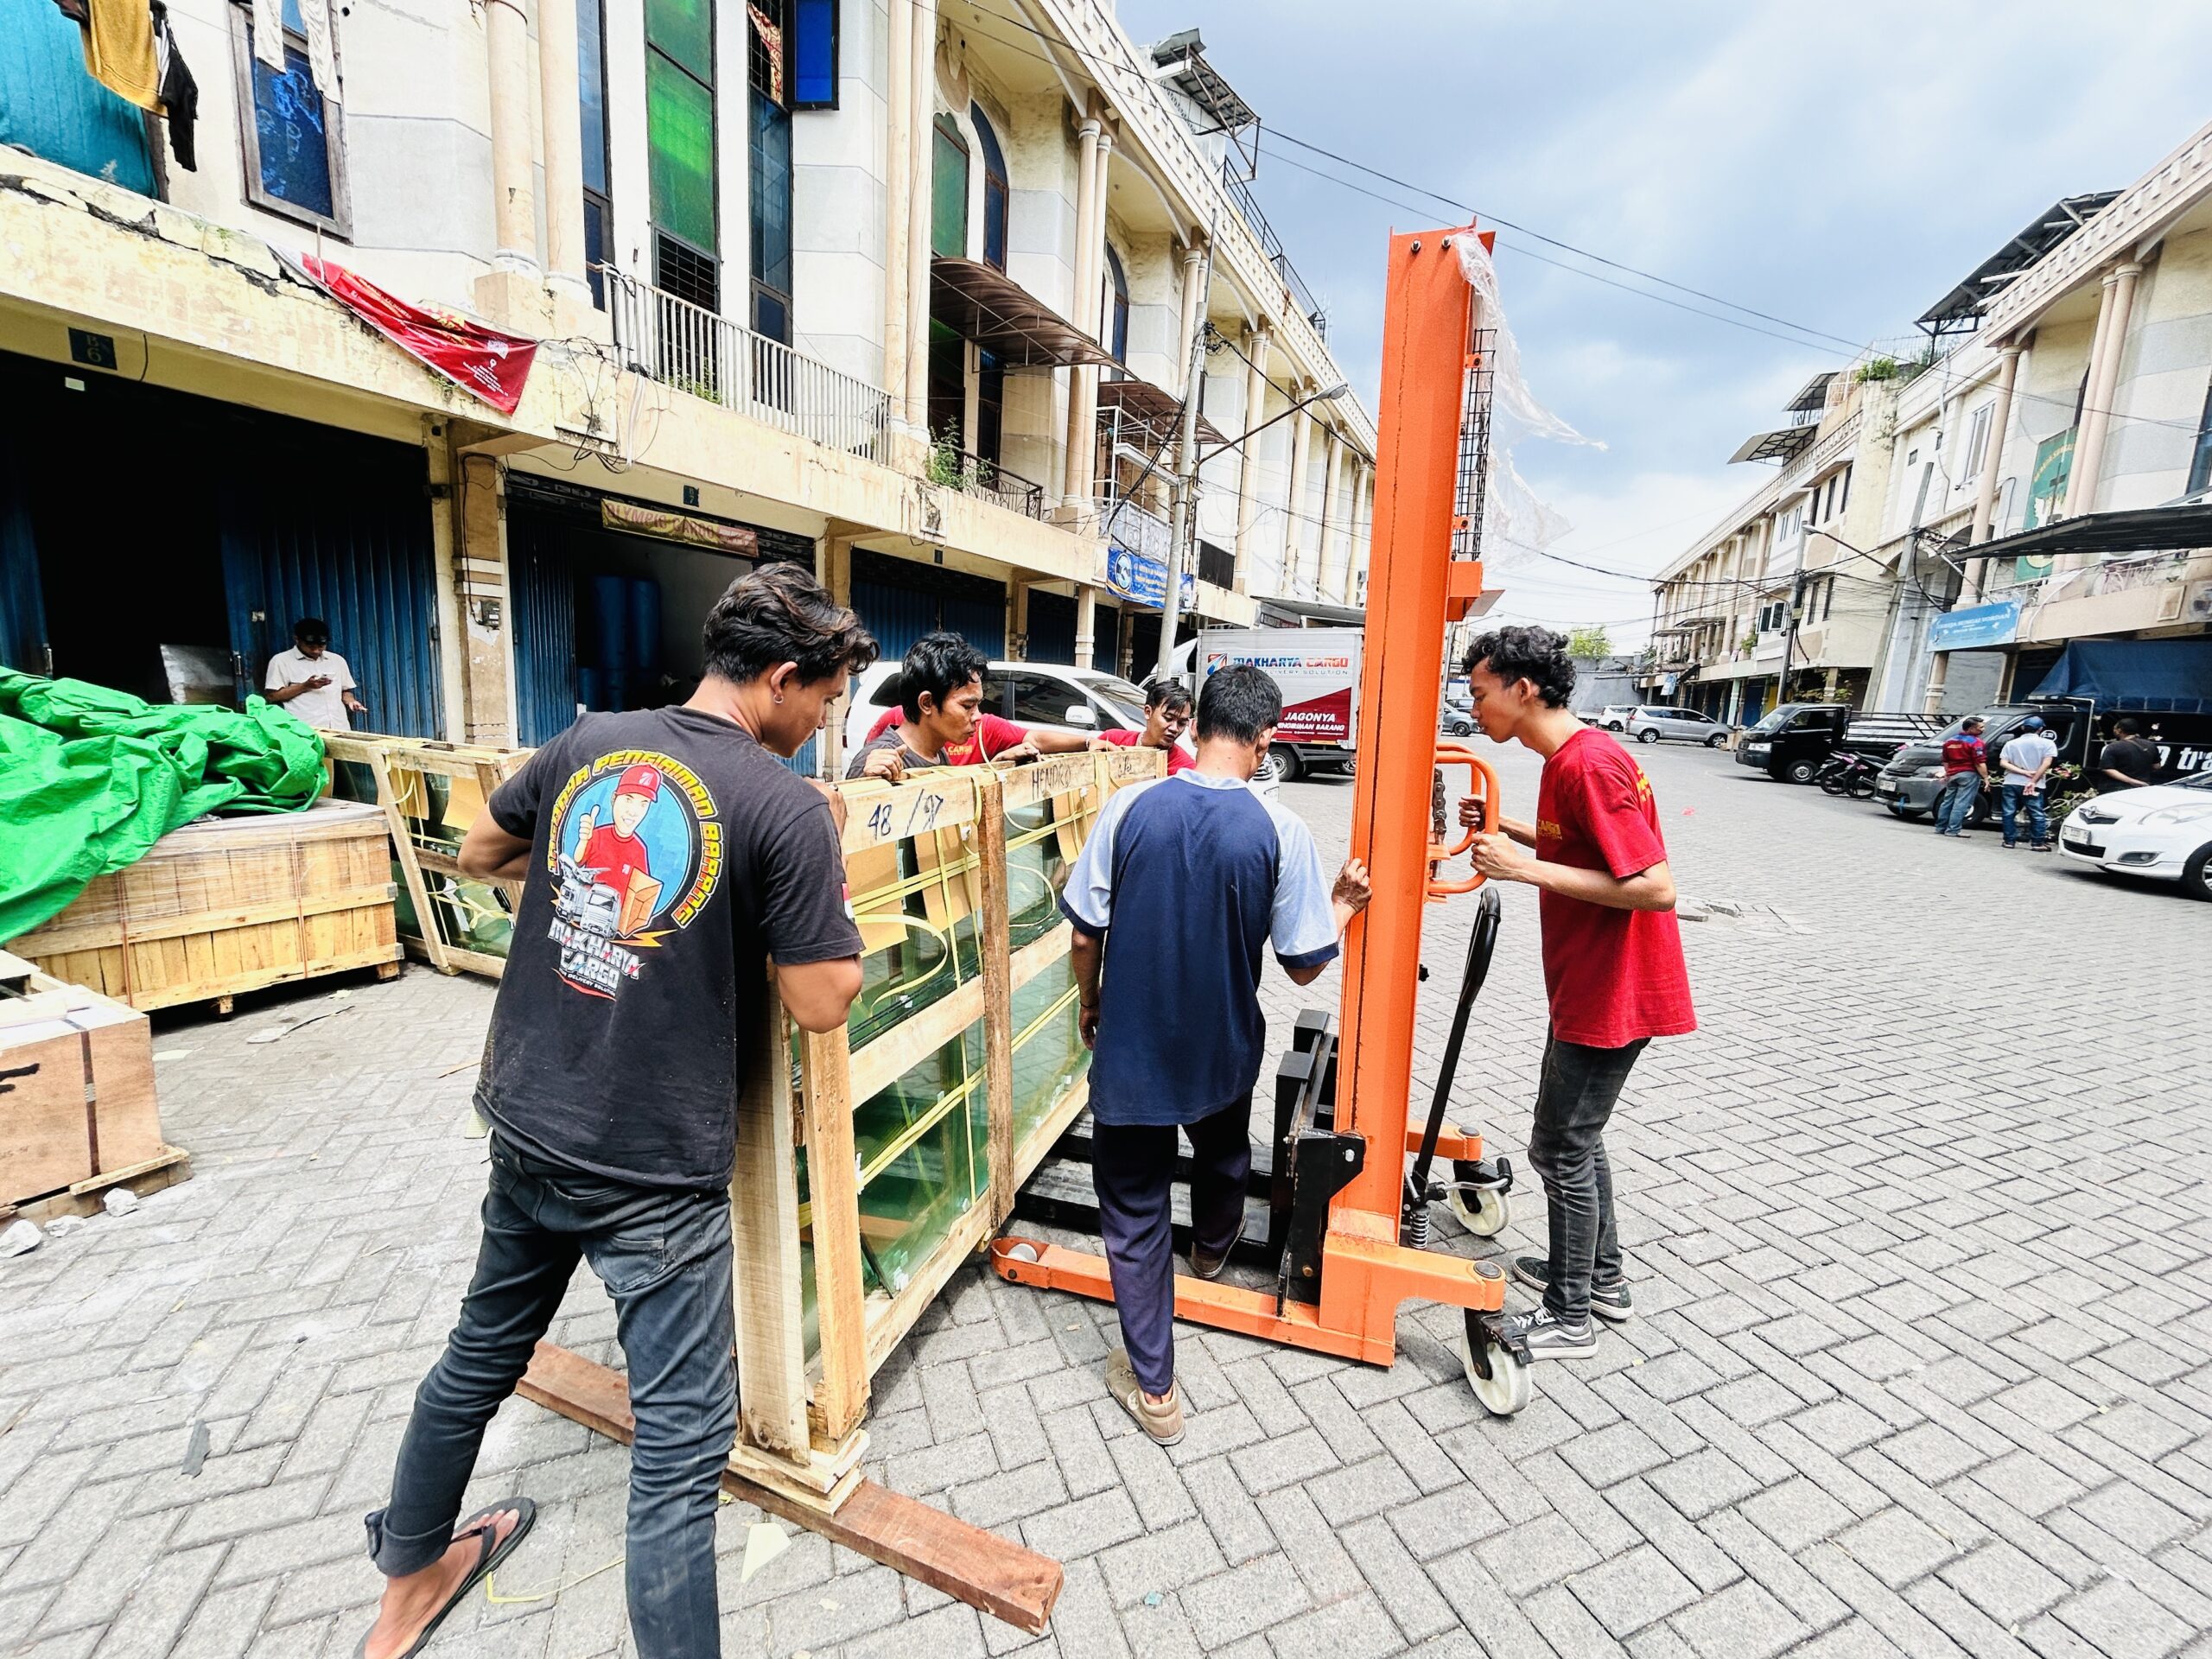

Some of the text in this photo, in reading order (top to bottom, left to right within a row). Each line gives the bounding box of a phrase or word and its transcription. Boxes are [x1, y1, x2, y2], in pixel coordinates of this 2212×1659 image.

[86, 347, 102, 362] 6
[606, 502, 668, 530] OLYMPIC
[1233, 657, 1349, 668] MAKHARYA CARGO
[1277, 721, 1345, 732] ENGIRIMAN BARANG
[1283, 712, 1336, 723] JAGONYA
[868, 803, 893, 842] 48
[671, 822, 724, 929] BARANG
[548, 917, 639, 980] MAKHARYA
[559, 947, 620, 991] CARGO
[567, 973, 594, 986] DELIVERY
